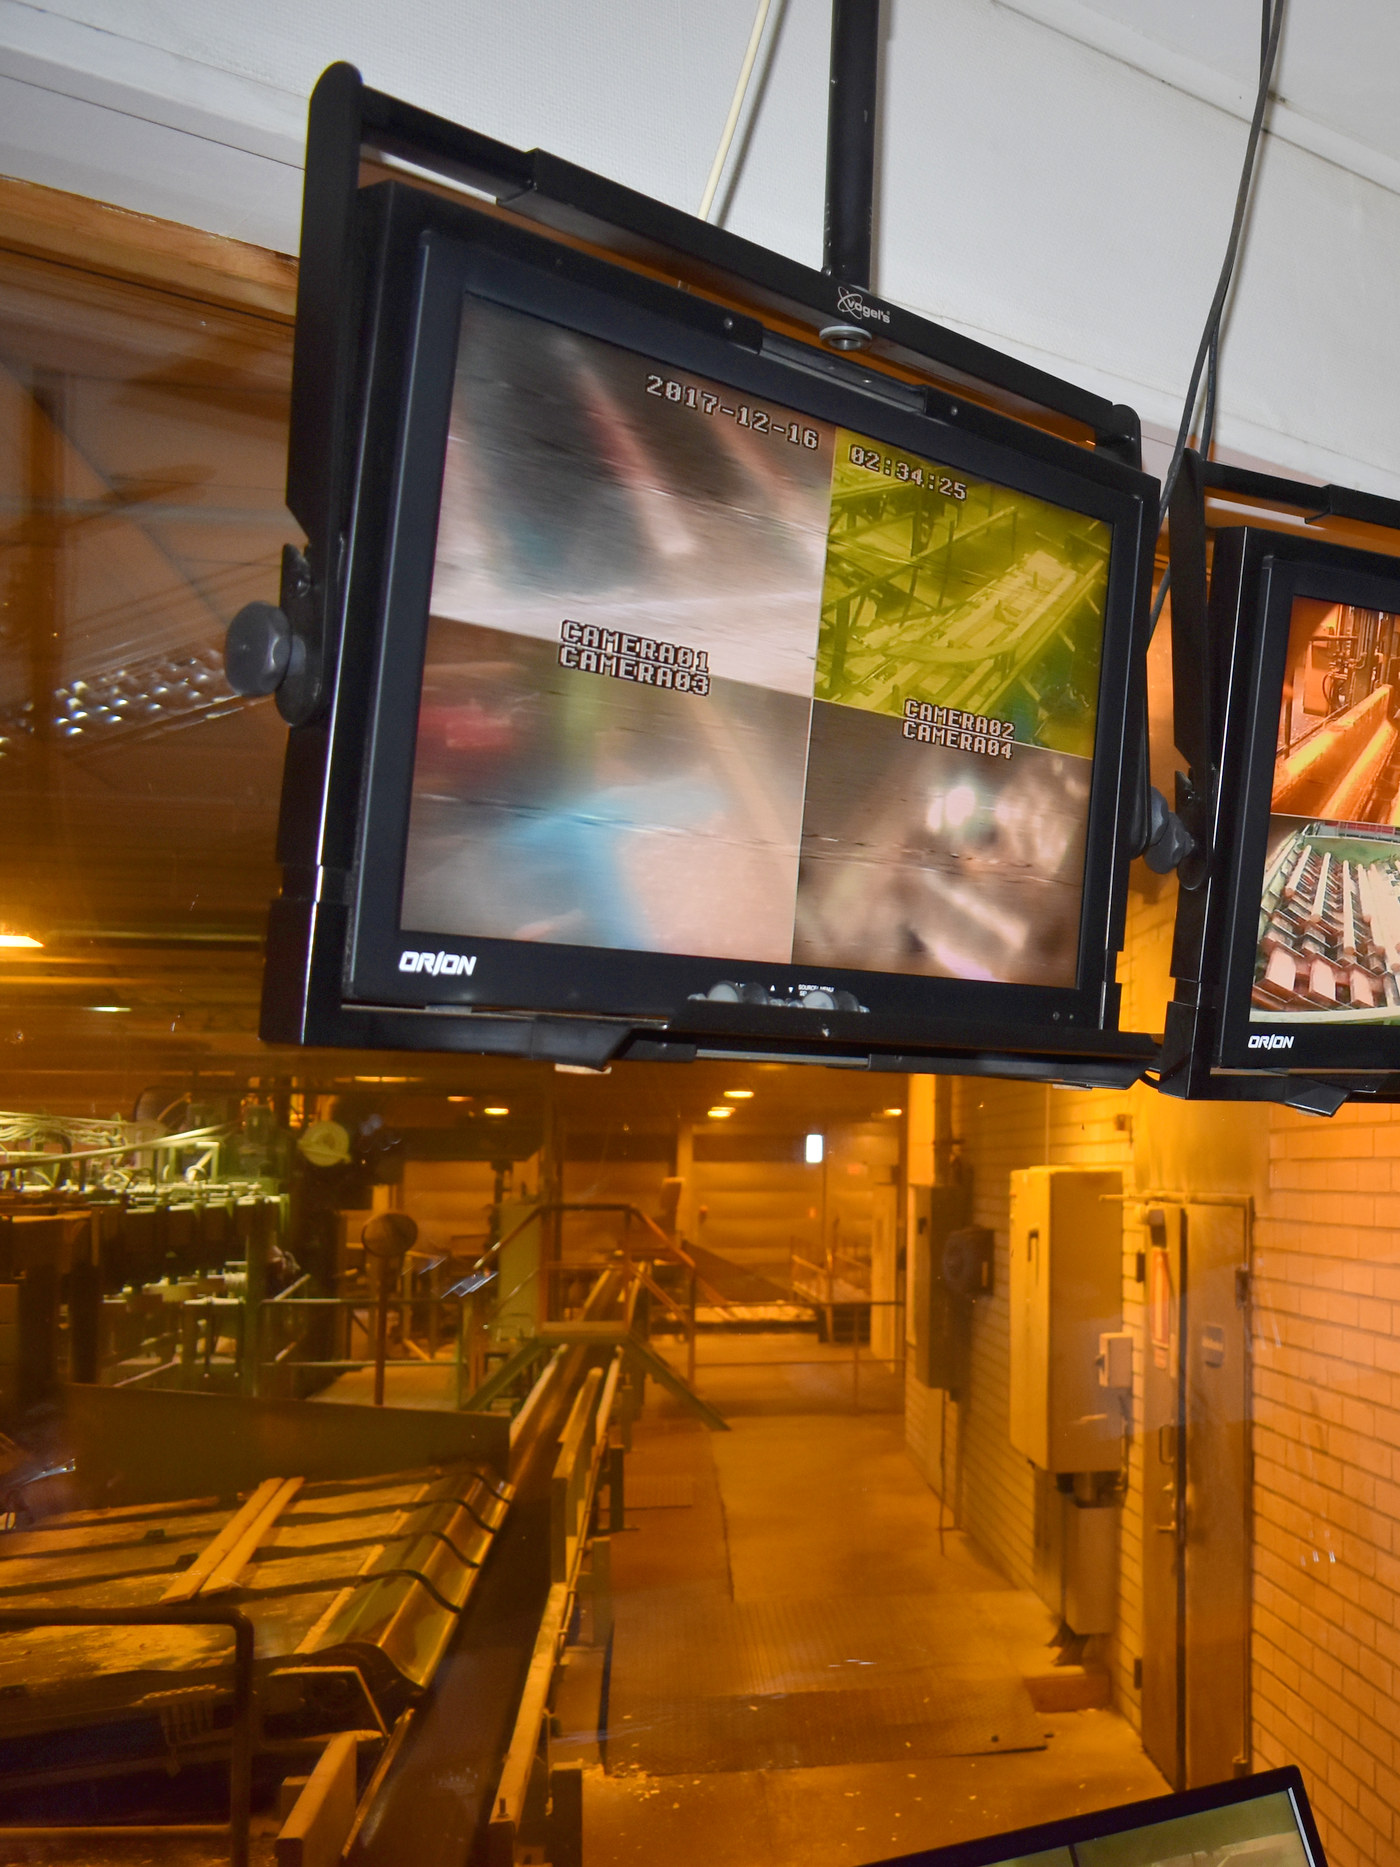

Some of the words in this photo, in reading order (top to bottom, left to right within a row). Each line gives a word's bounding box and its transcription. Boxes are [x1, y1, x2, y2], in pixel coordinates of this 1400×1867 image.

[847, 298, 891, 324] vogel's
[645, 374, 819, 451] 2017-12-16
[848, 444, 968, 502] 02:34:25
[560, 619, 710, 673] CAMERA01
[558, 643, 710, 698] CAMERA03
[901, 719, 1014, 760] CAMERA04
[903, 698, 1016, 742] CAMERA02
[398, 950, 477, 977] ORION
[1247, 1034, 1295, 1050] ORION
